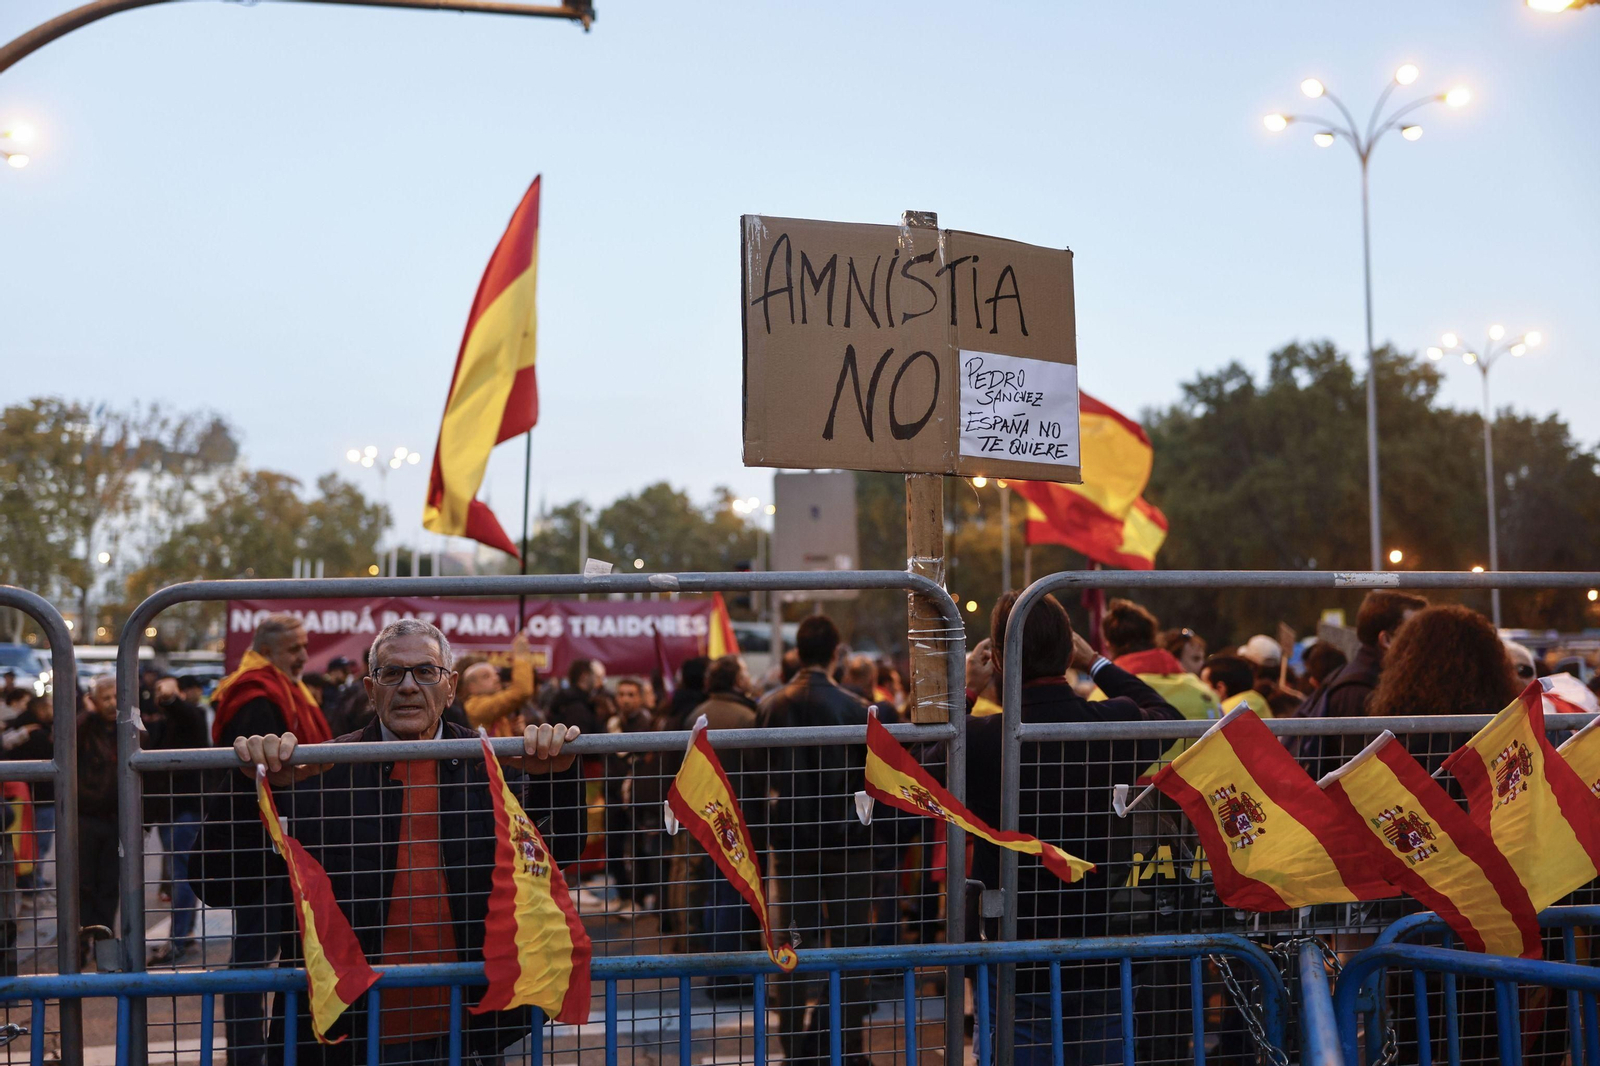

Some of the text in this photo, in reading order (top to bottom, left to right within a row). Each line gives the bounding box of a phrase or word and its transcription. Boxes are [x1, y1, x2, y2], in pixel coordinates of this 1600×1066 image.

[751, 233, 1029, 337] AMNISTIA
[965, 357, 1025, 391] PEDRO
[822, 344, 940, 443] NO
[976, 389, 1044, 413] SANCHEZ
[965, 411, 1061, 439] ESPAÑA NO
[977, 436, 1068, 460] TE QUIERE
[440, 612, 510, 637] PARA
